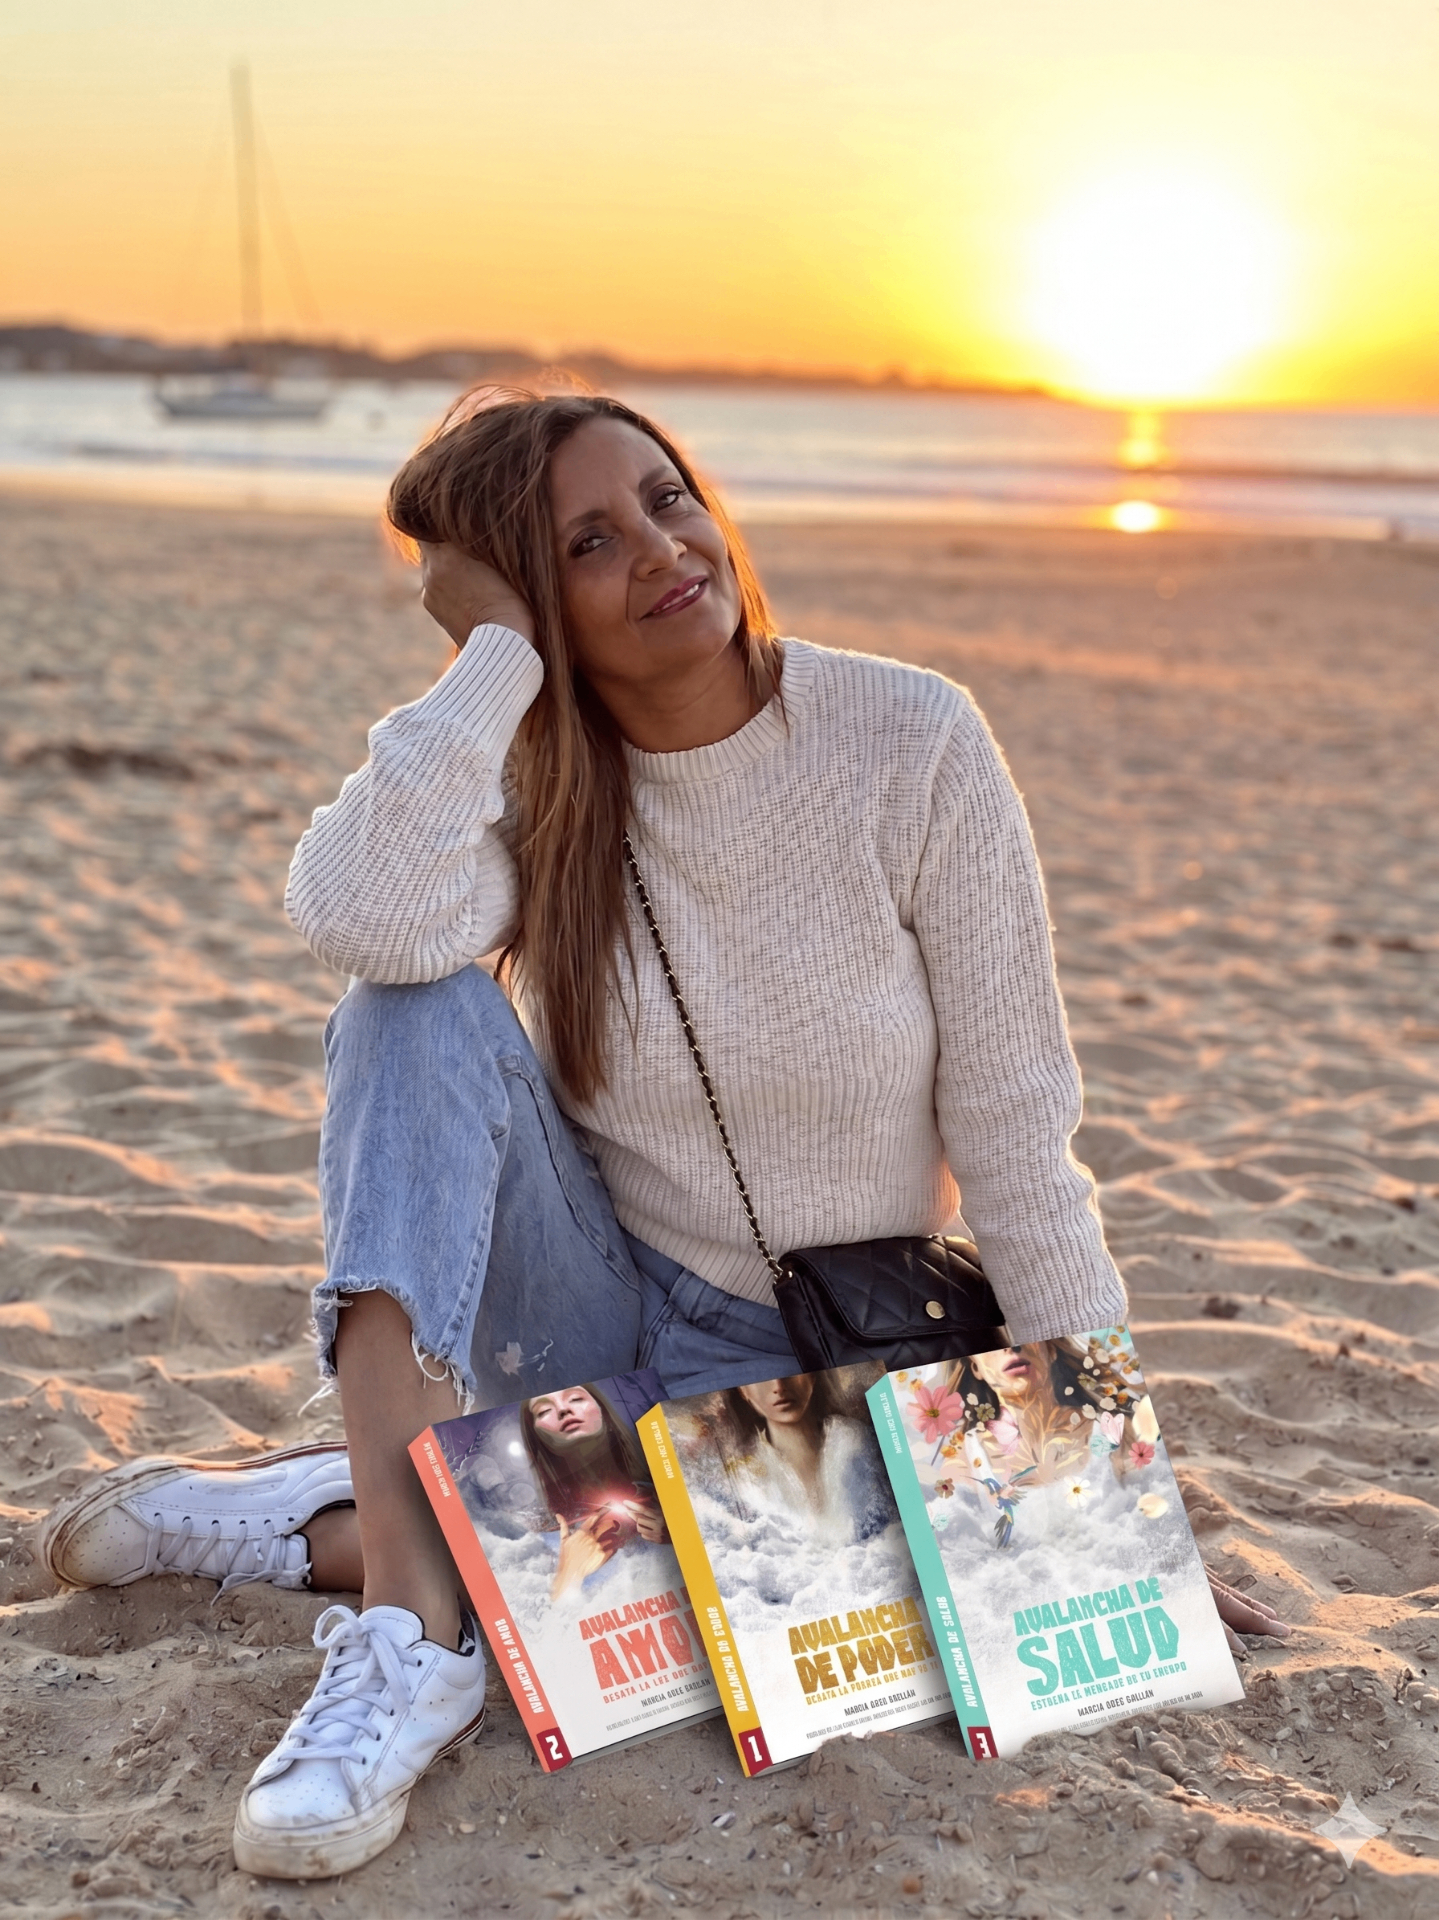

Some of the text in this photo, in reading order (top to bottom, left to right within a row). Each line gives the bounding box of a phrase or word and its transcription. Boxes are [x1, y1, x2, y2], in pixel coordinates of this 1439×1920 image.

[579, 1590, 682, 1640] AVALANCHA
[787, 1596, 923, 1655] AVALANCHA
[1013, 1576, 1164, 1636] AVALANCHA DE
[507, 1646, 521, 1660] DE
[793, 1623, 935, 1695] DE PODER
[1016, 1605, 1180, 1696] SALUD
[639, 1681, 651, 1692] LA
[838, 1687, 849, 1697] LA
[545, 1735, 563, 1760] 2
[747, 1735, 763, 1763] 1
